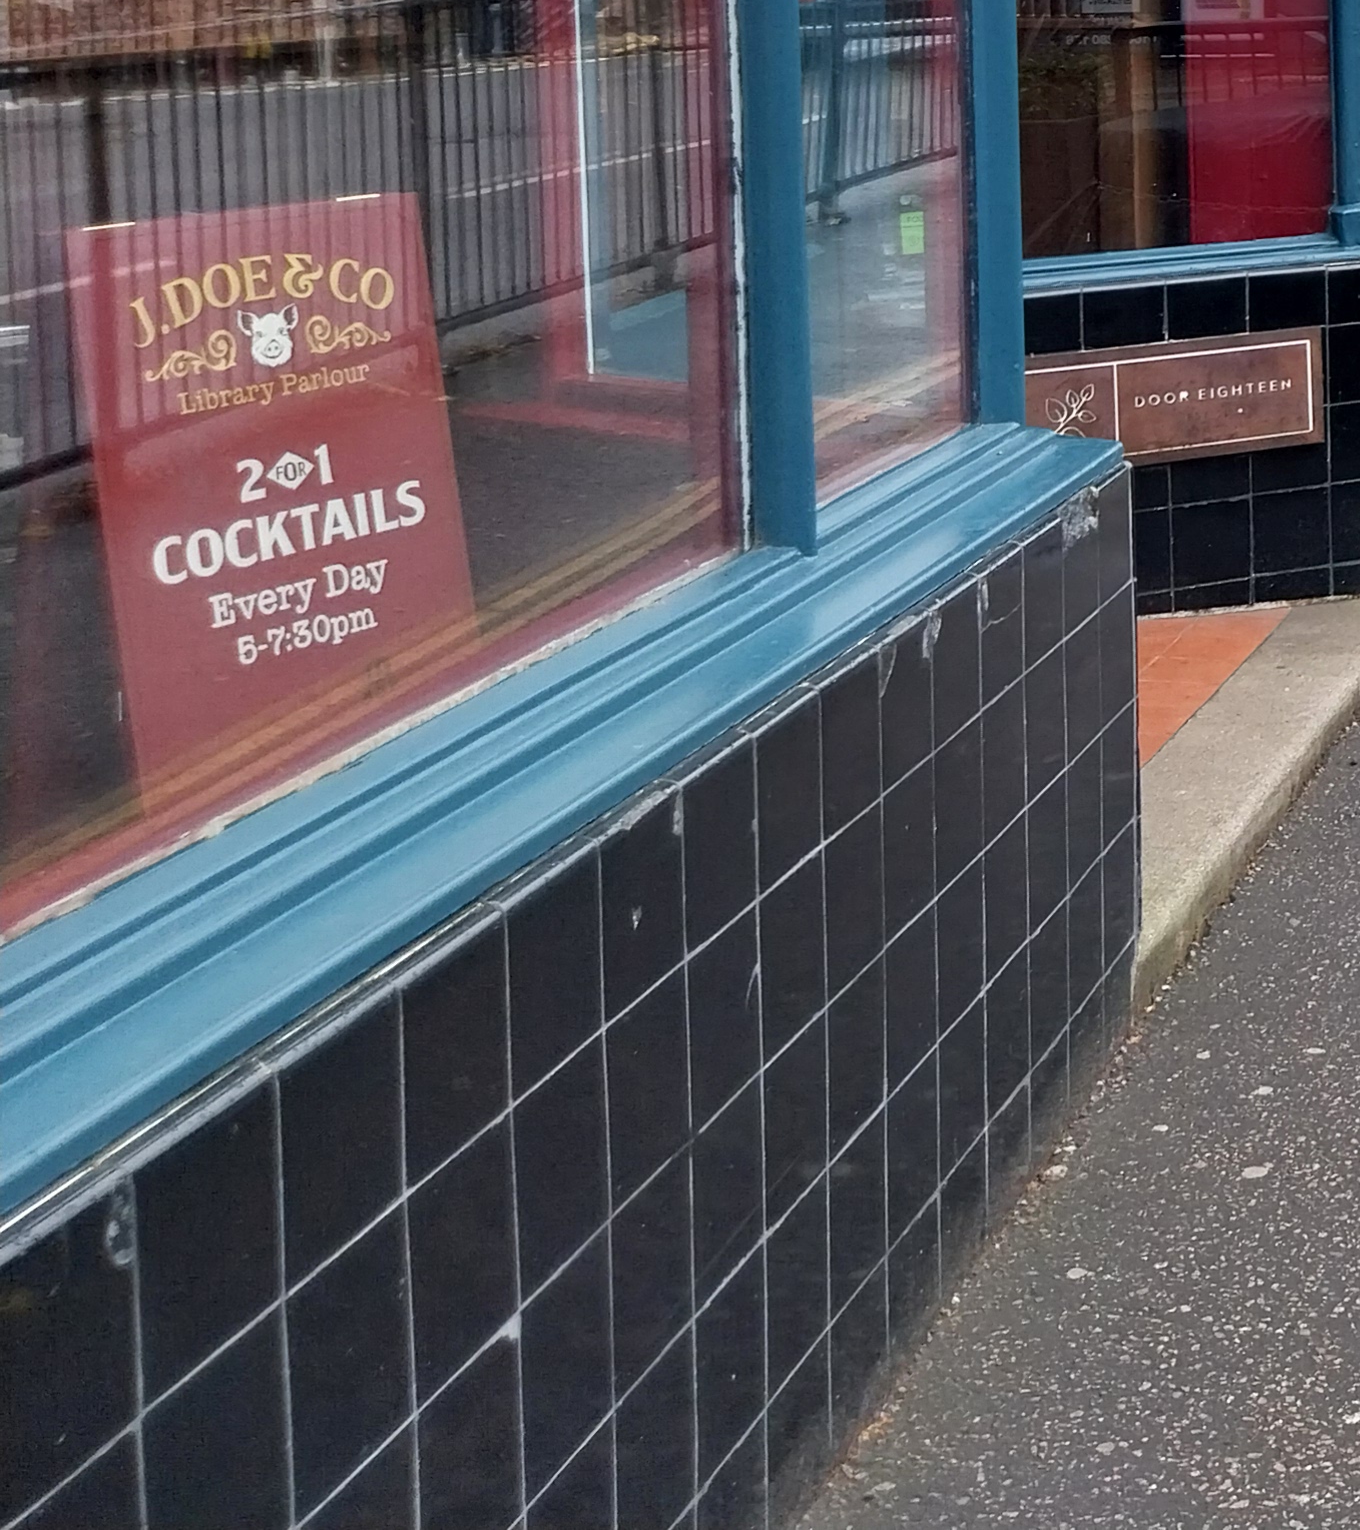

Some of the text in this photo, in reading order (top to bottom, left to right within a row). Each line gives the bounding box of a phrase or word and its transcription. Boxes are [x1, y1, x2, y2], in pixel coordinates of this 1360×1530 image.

[129, 253, 395, 349] J.DOE & CO
[176, 363, 370, 416] Library Parlour
[1134, 378, 1293, 408] DOOR EIGHTEEN
[236, 443, 335, 504] 2 FOR 1
[153, 479, 426, 586] COCKTAILS
[208, 559, 389, 629] Every Day
[237, 607, 379, 665] 5-7:30pm
